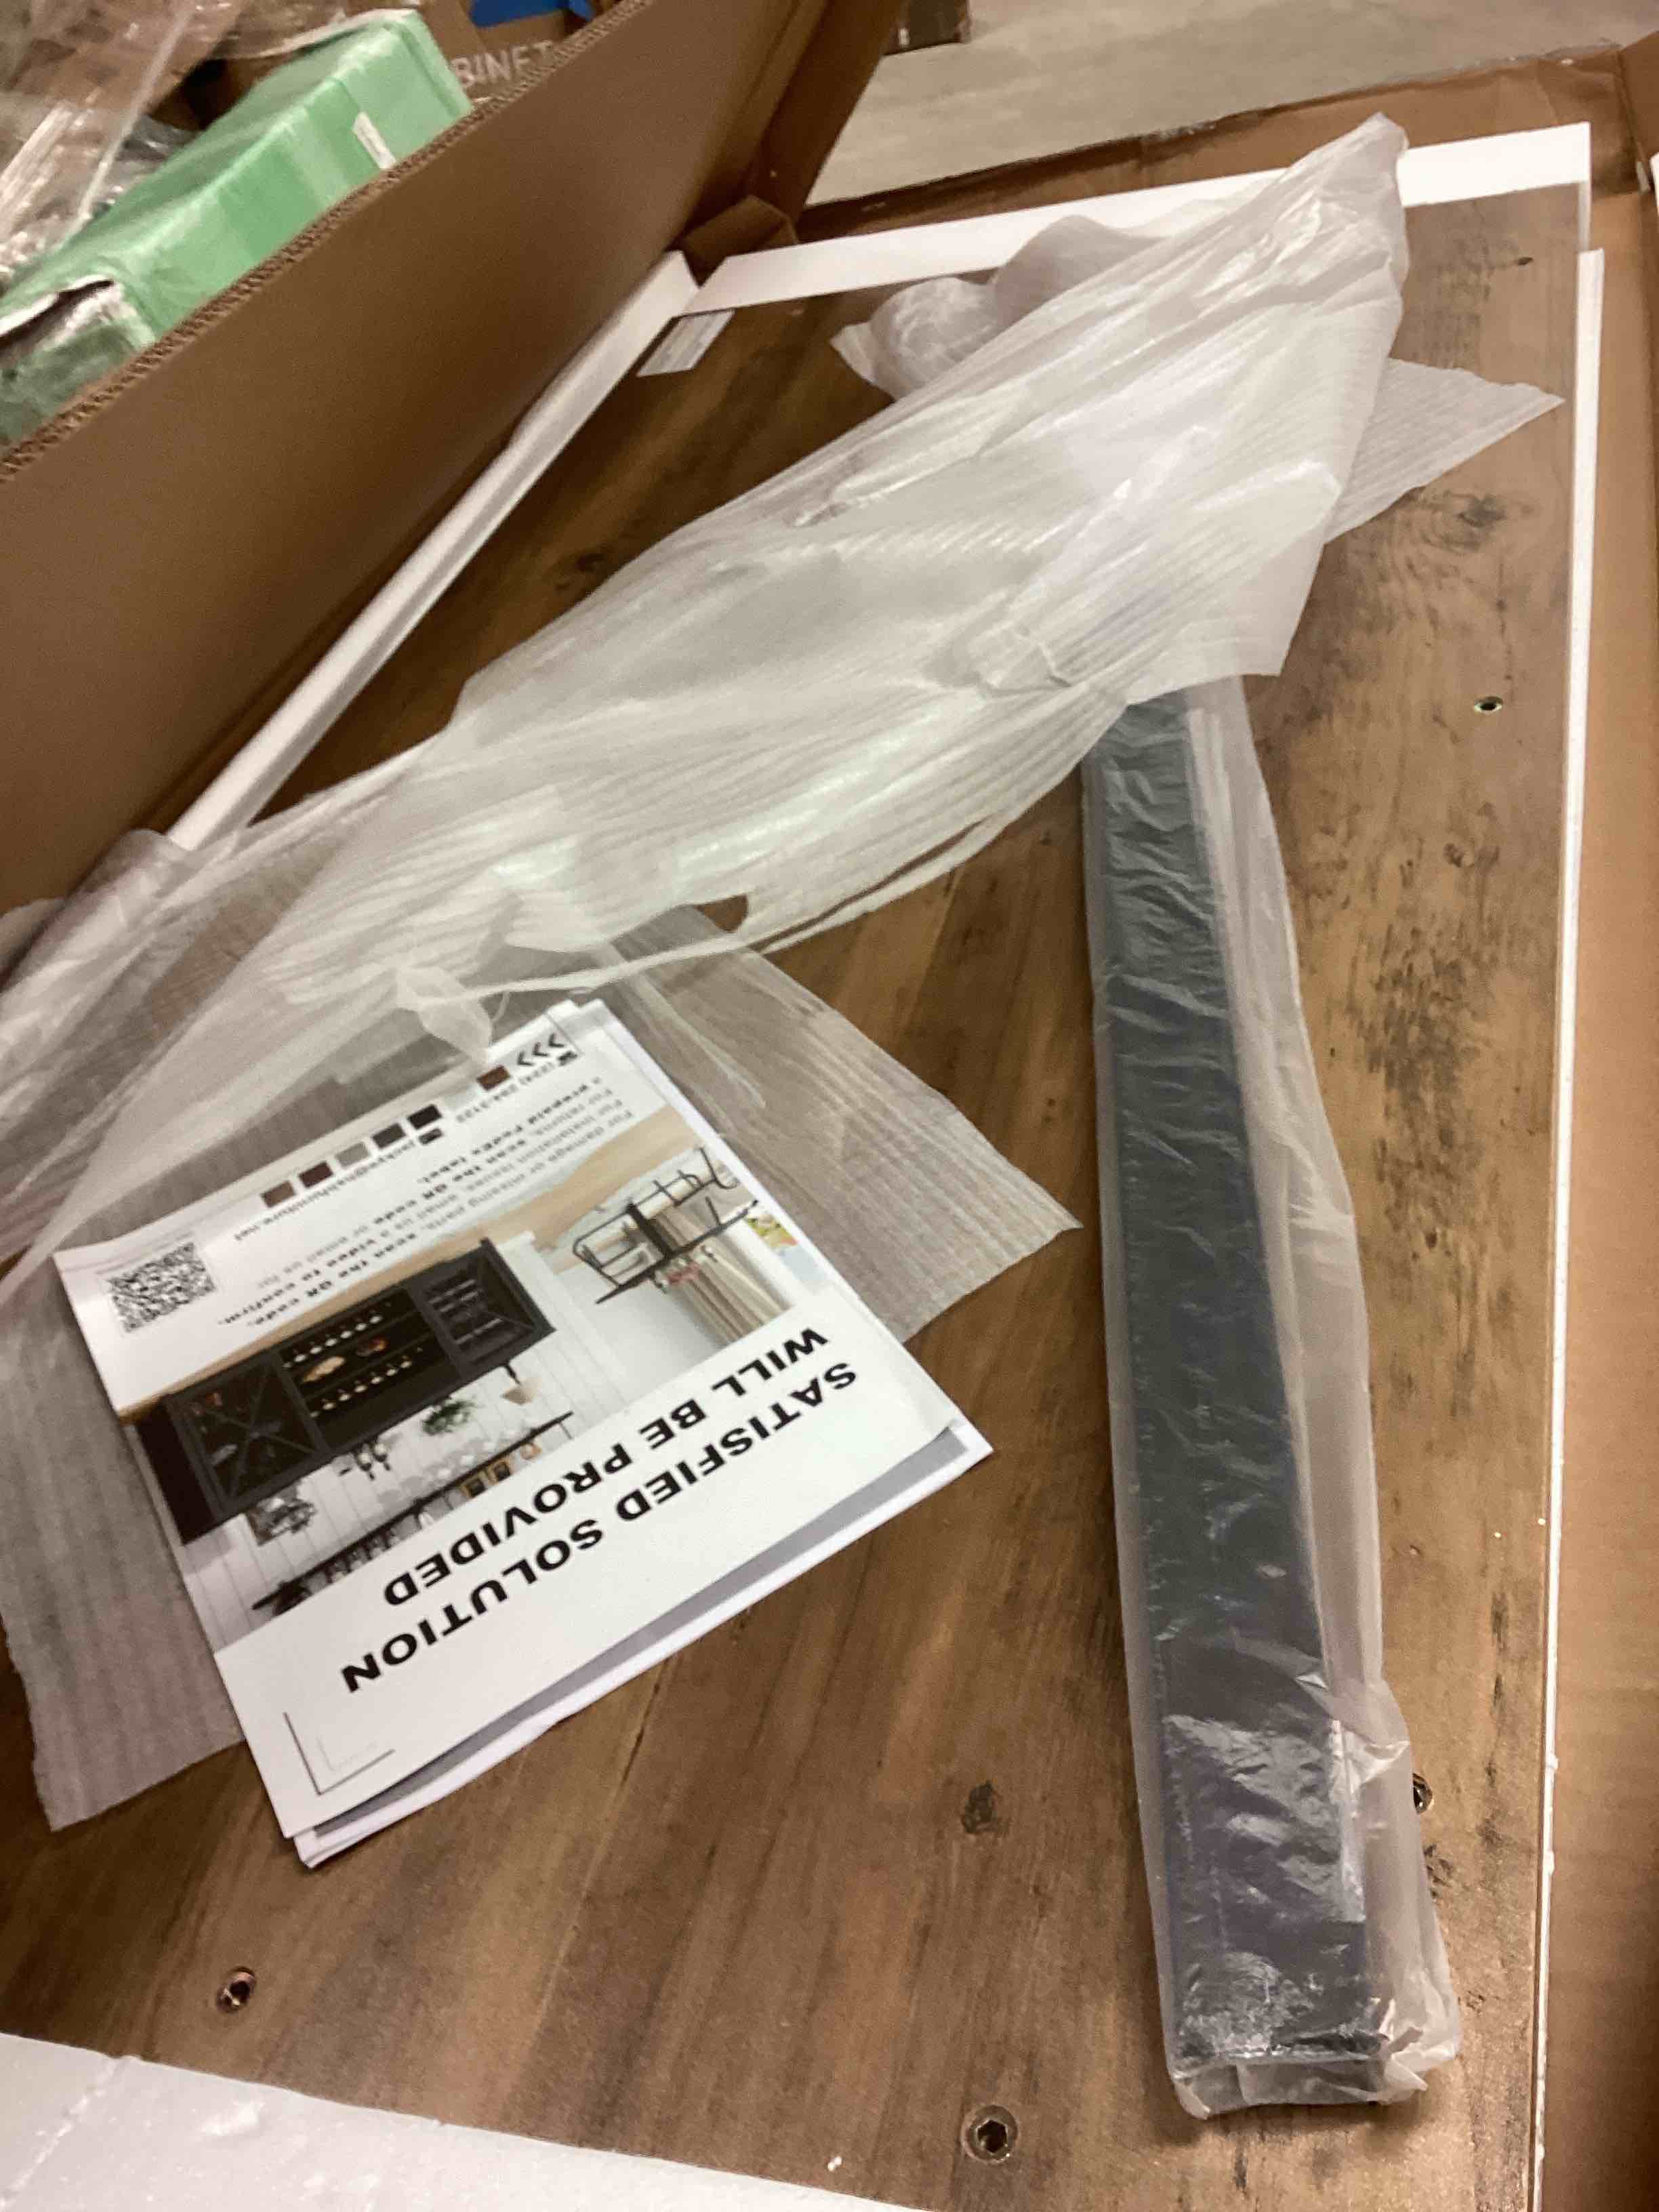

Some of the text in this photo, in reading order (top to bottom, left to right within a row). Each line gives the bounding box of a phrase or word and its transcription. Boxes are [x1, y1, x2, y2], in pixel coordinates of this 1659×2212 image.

[525, 1081, 590, 1129] prepaid
[485, 1137, 527, 1167] scan
[546, 1123, 606, 1166] damage
[466, 1172, 527, 1210] missing
[371, 1197, 418, 1228] code
[324, 1236, 377, 1270] video
[373, 1231, 416, 1260] scan
[378, 1322, 827, 1610] WILL BE PROVIDED
[338, 1358, 857, 1694] SATISFIED SOLUTION
